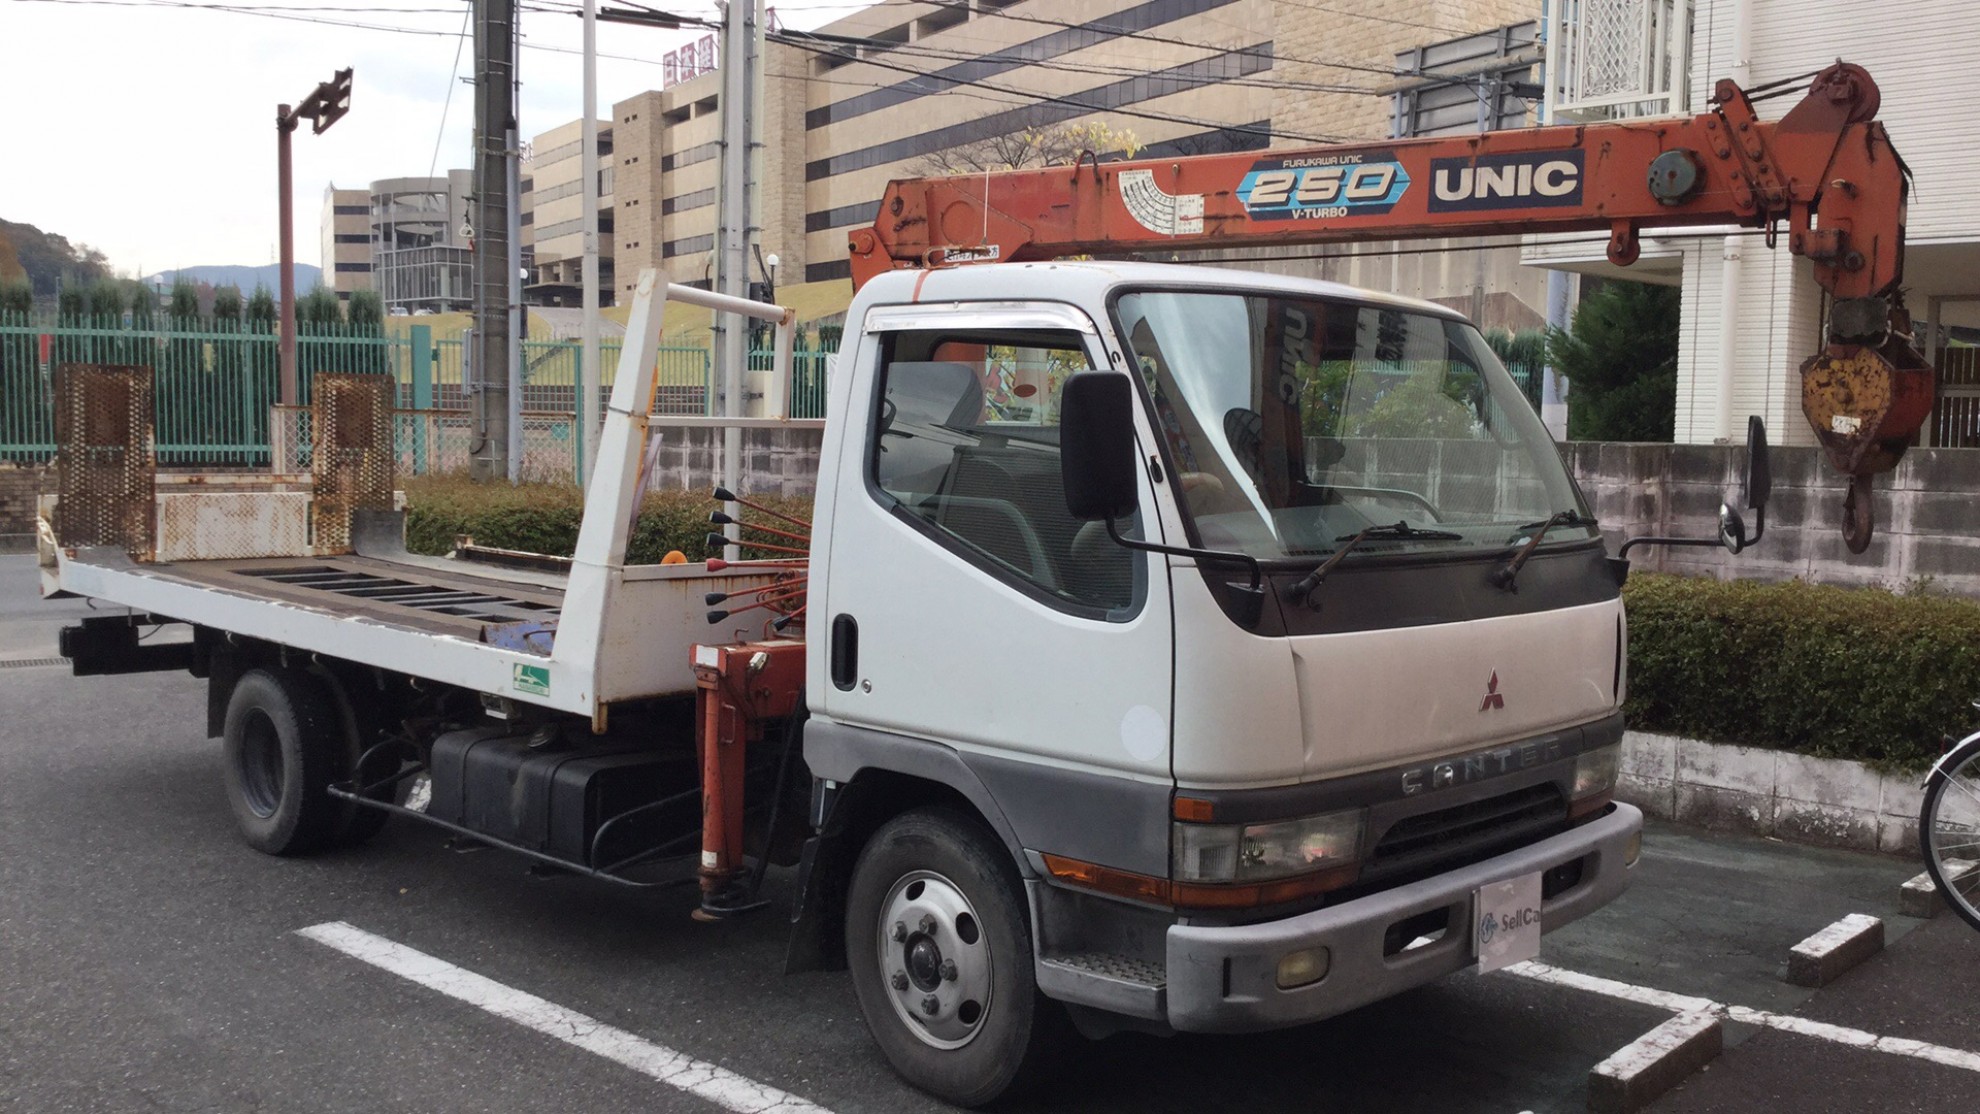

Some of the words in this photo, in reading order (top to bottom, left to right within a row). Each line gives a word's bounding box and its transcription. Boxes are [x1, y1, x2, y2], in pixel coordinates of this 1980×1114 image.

[1283, 156, 1338, 168] FURUKAWA
[1340, 154, 1363, 165] UNIC
[1435, 160, 1578, 201] UNIC
[1250, 164, 1397, 205] 250
[1401, 737, 1561, 796] CANTER
